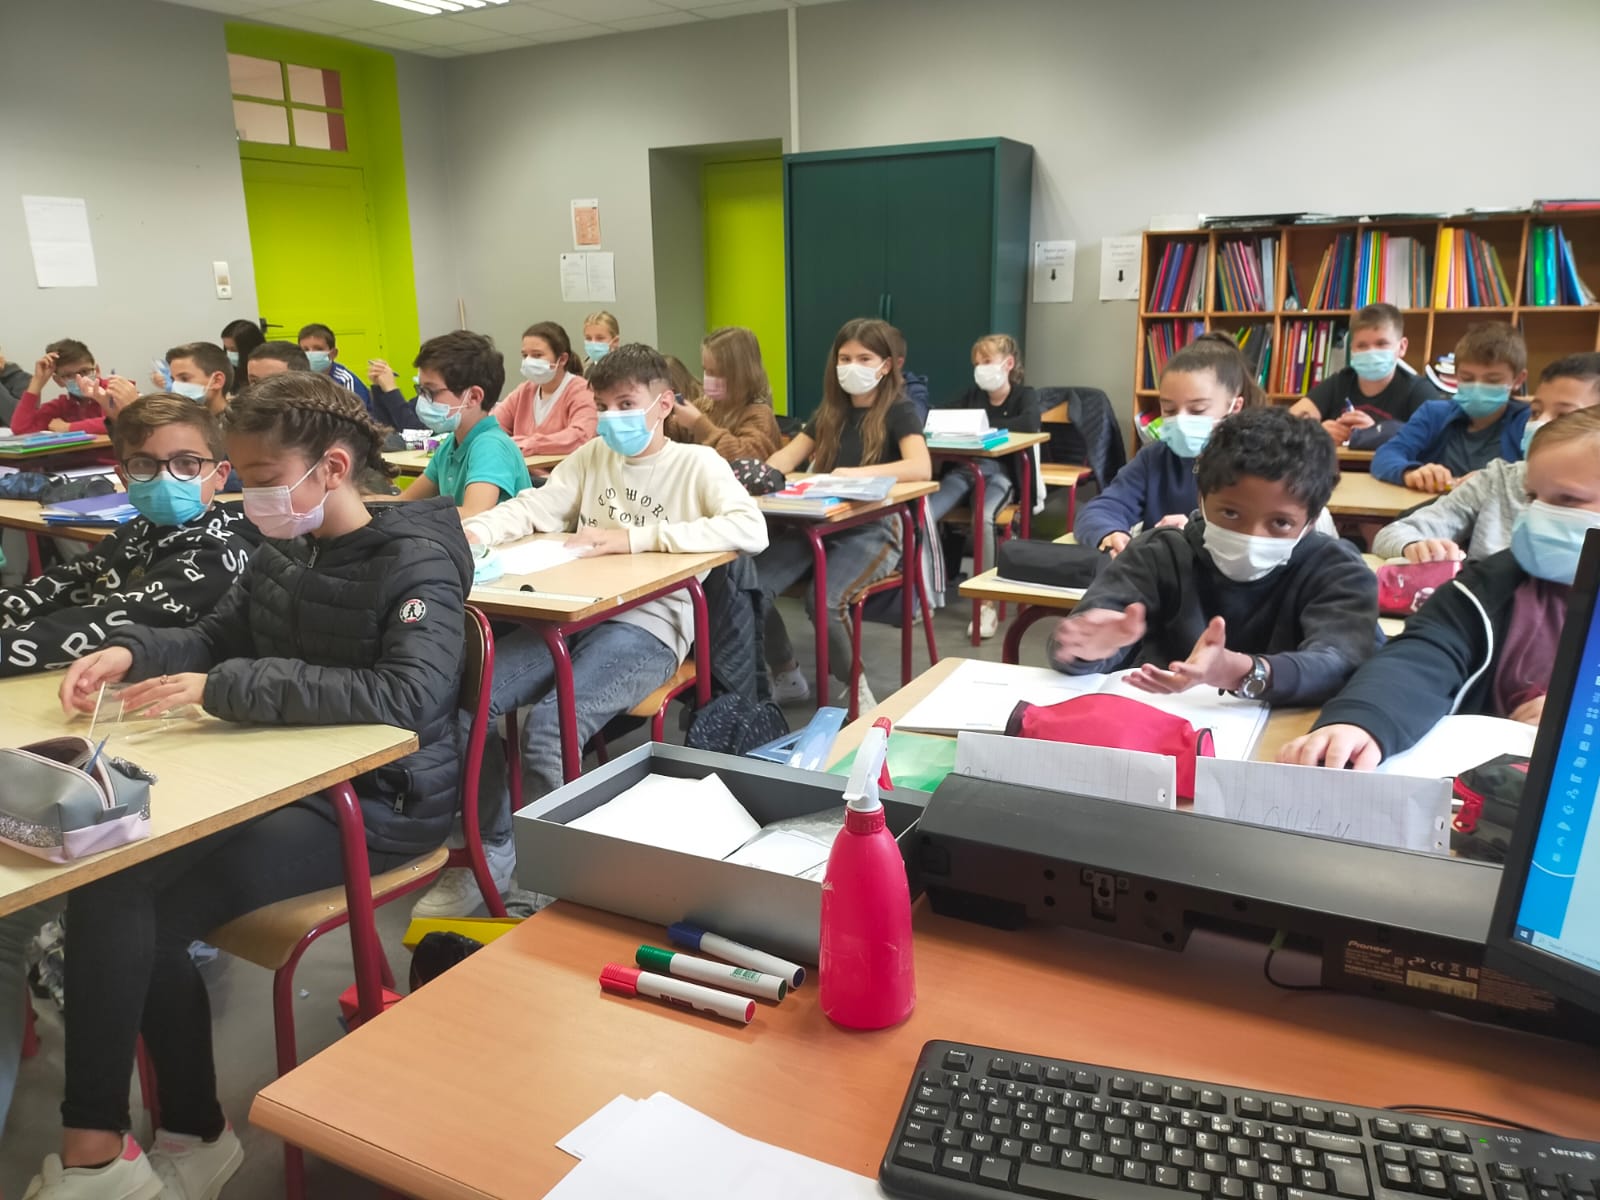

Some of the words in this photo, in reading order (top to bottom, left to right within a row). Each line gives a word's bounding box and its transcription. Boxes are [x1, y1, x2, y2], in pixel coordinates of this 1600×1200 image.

[1048, 1108, 1055, 1116] R
[1083, 1133, 1091, 1141] G
[1496, 1134, 1522, 1144] K120
[903, 1141, 916, 1149] Ctrl
[1034, 1145, 1042, 1153] C
[1127, 1162, 1135, 1170] N
[1239, 1159, 1248, 1168] M
[1505, 1183, 1512, 1191] 7
[1290, 1188, 1303, 1198] Maj
